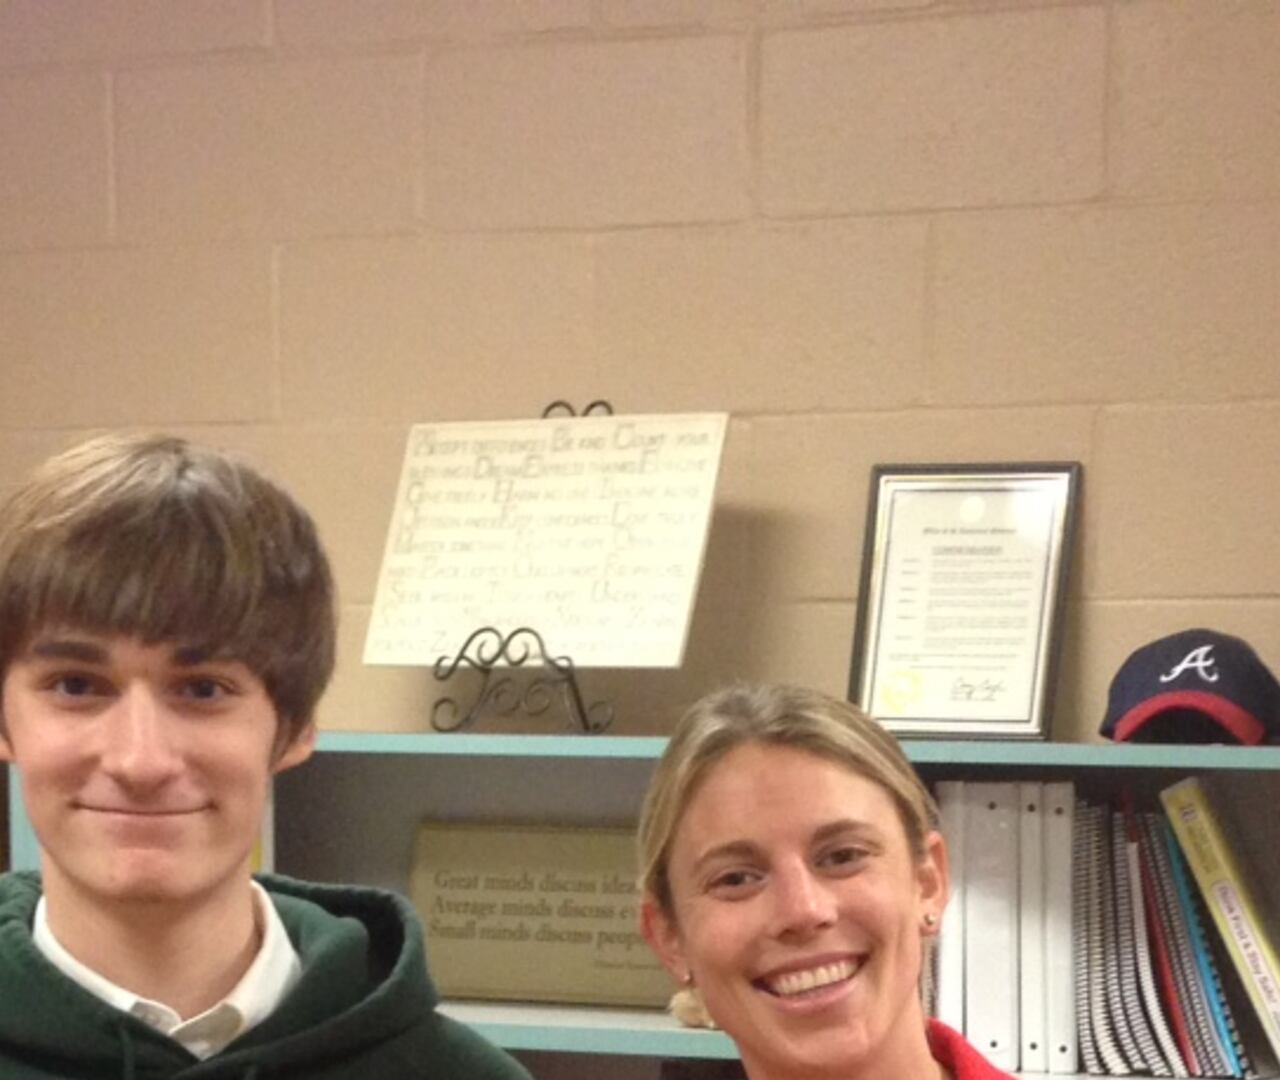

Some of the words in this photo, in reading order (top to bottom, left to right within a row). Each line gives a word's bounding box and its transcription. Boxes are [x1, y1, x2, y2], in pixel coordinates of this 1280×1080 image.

[1160, 644, 1219, 682] A
[434, 871, 478, 890] Great
[484, 873, 533, 891] minds
[539, 873, 597, 893] discuss
[432, 896, 496, 919] Average
[502, 898, 552, 916] minds
[557, 899, 615, 918] discuss
[480, 922, 530, 940] minds
[535, 924, 593, 943] discuss
